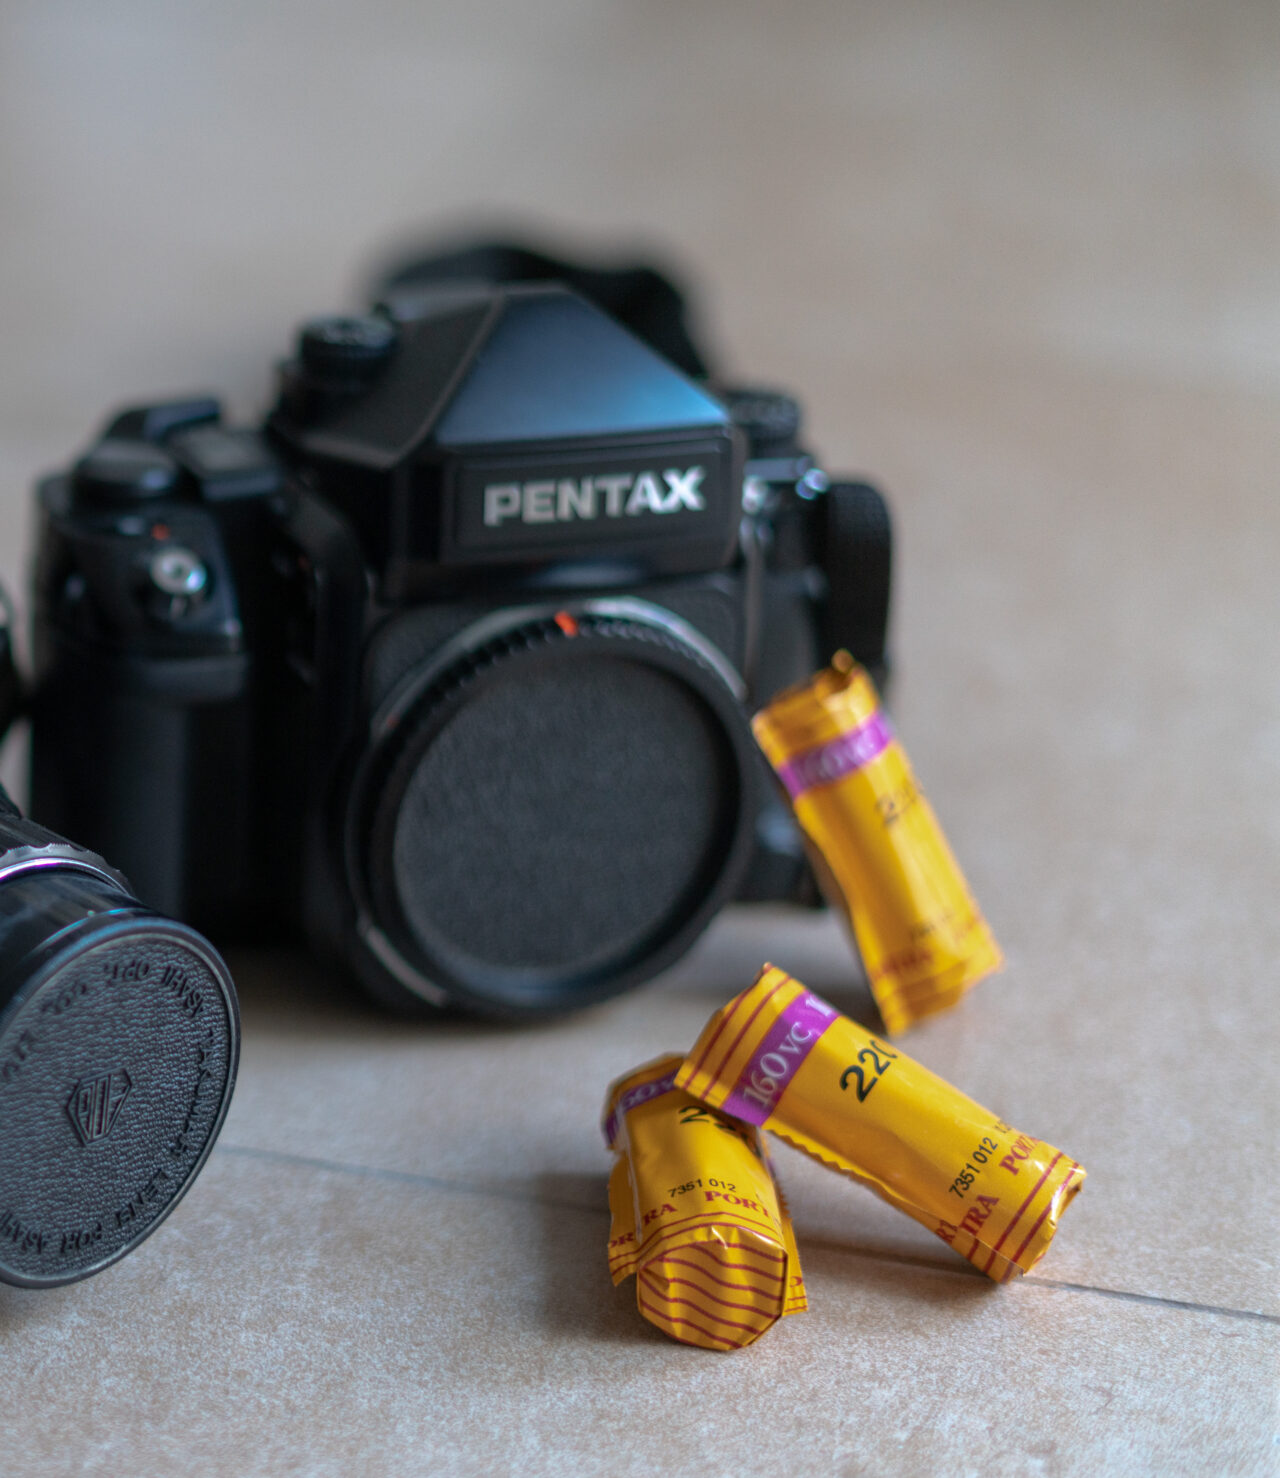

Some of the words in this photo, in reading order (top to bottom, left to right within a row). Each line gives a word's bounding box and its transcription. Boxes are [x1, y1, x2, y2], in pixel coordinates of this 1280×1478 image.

[484, 465, 705, 526] PENTAX
[161, 965, 204, 1018] ASAHI
[743, 1053, 789, 1109] 160
[668, 1178, 703, 1198] 7351
[709, 1178, 737, 1193] 012
[949, 1163, 980, 1198] 7351
[973, 1137, 998, 1164] 012
